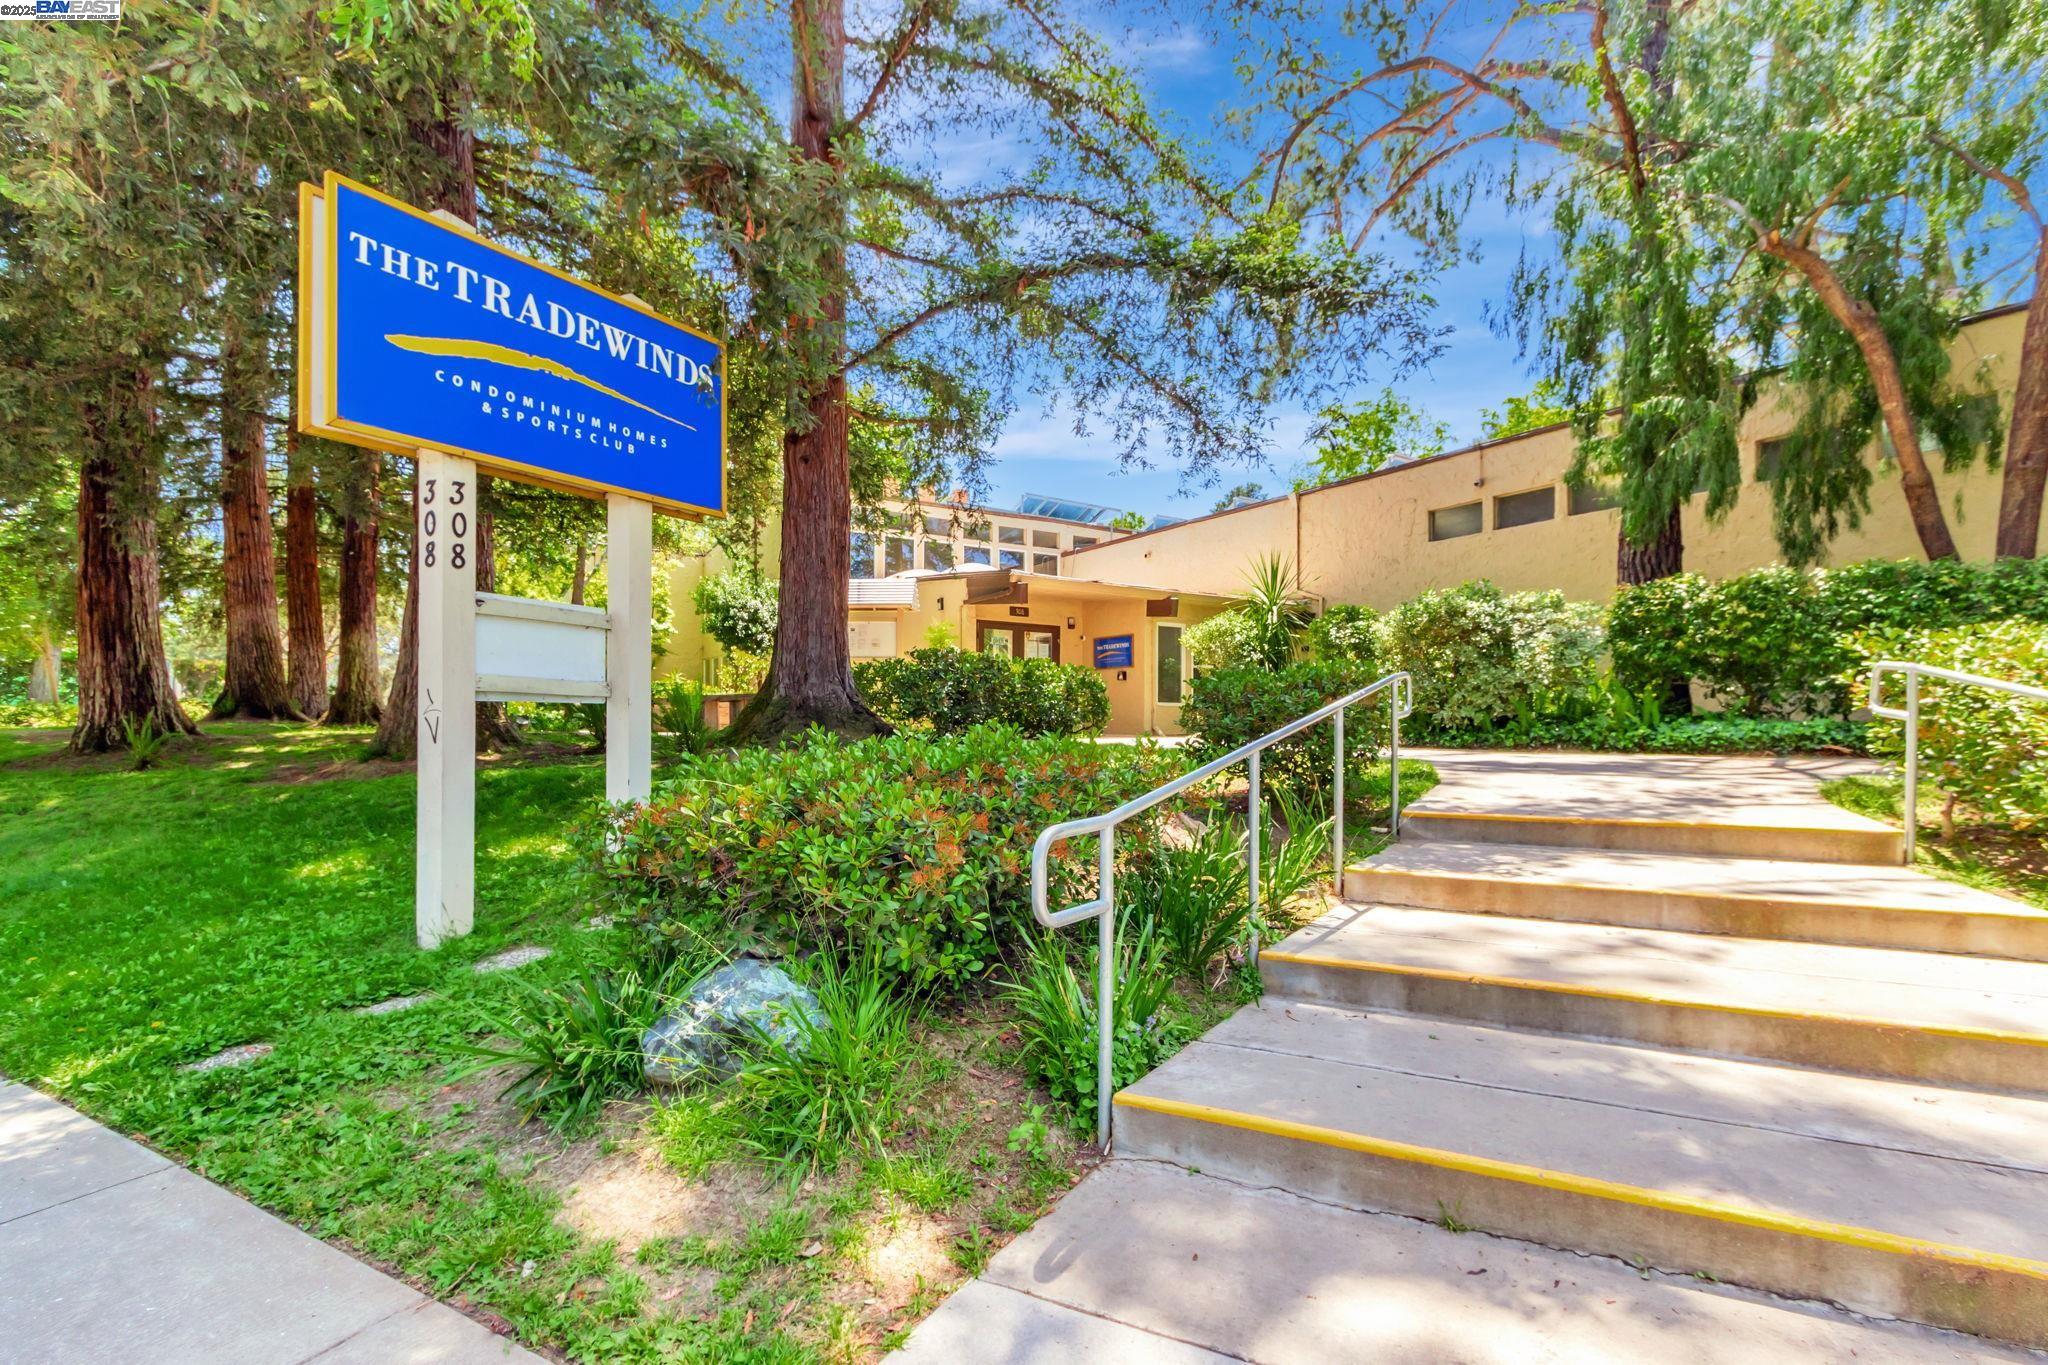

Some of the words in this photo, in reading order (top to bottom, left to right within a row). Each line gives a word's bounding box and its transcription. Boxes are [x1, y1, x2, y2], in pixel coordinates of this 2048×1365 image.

[349, 230, 440, 291] THE
[446, 260, 714, 391] TRADEWINDS
[435, 370, 602, 428] CONDOMINIUM
[608, 421, 668, 449] HOMES
[482, 401, 493, 414] &
[501, 406, 582, 439] SPORTS
[589, 432, 635, 454] CLUB
[423, 479, 437, 568] 308
[449, 480, 467, 570] 308
